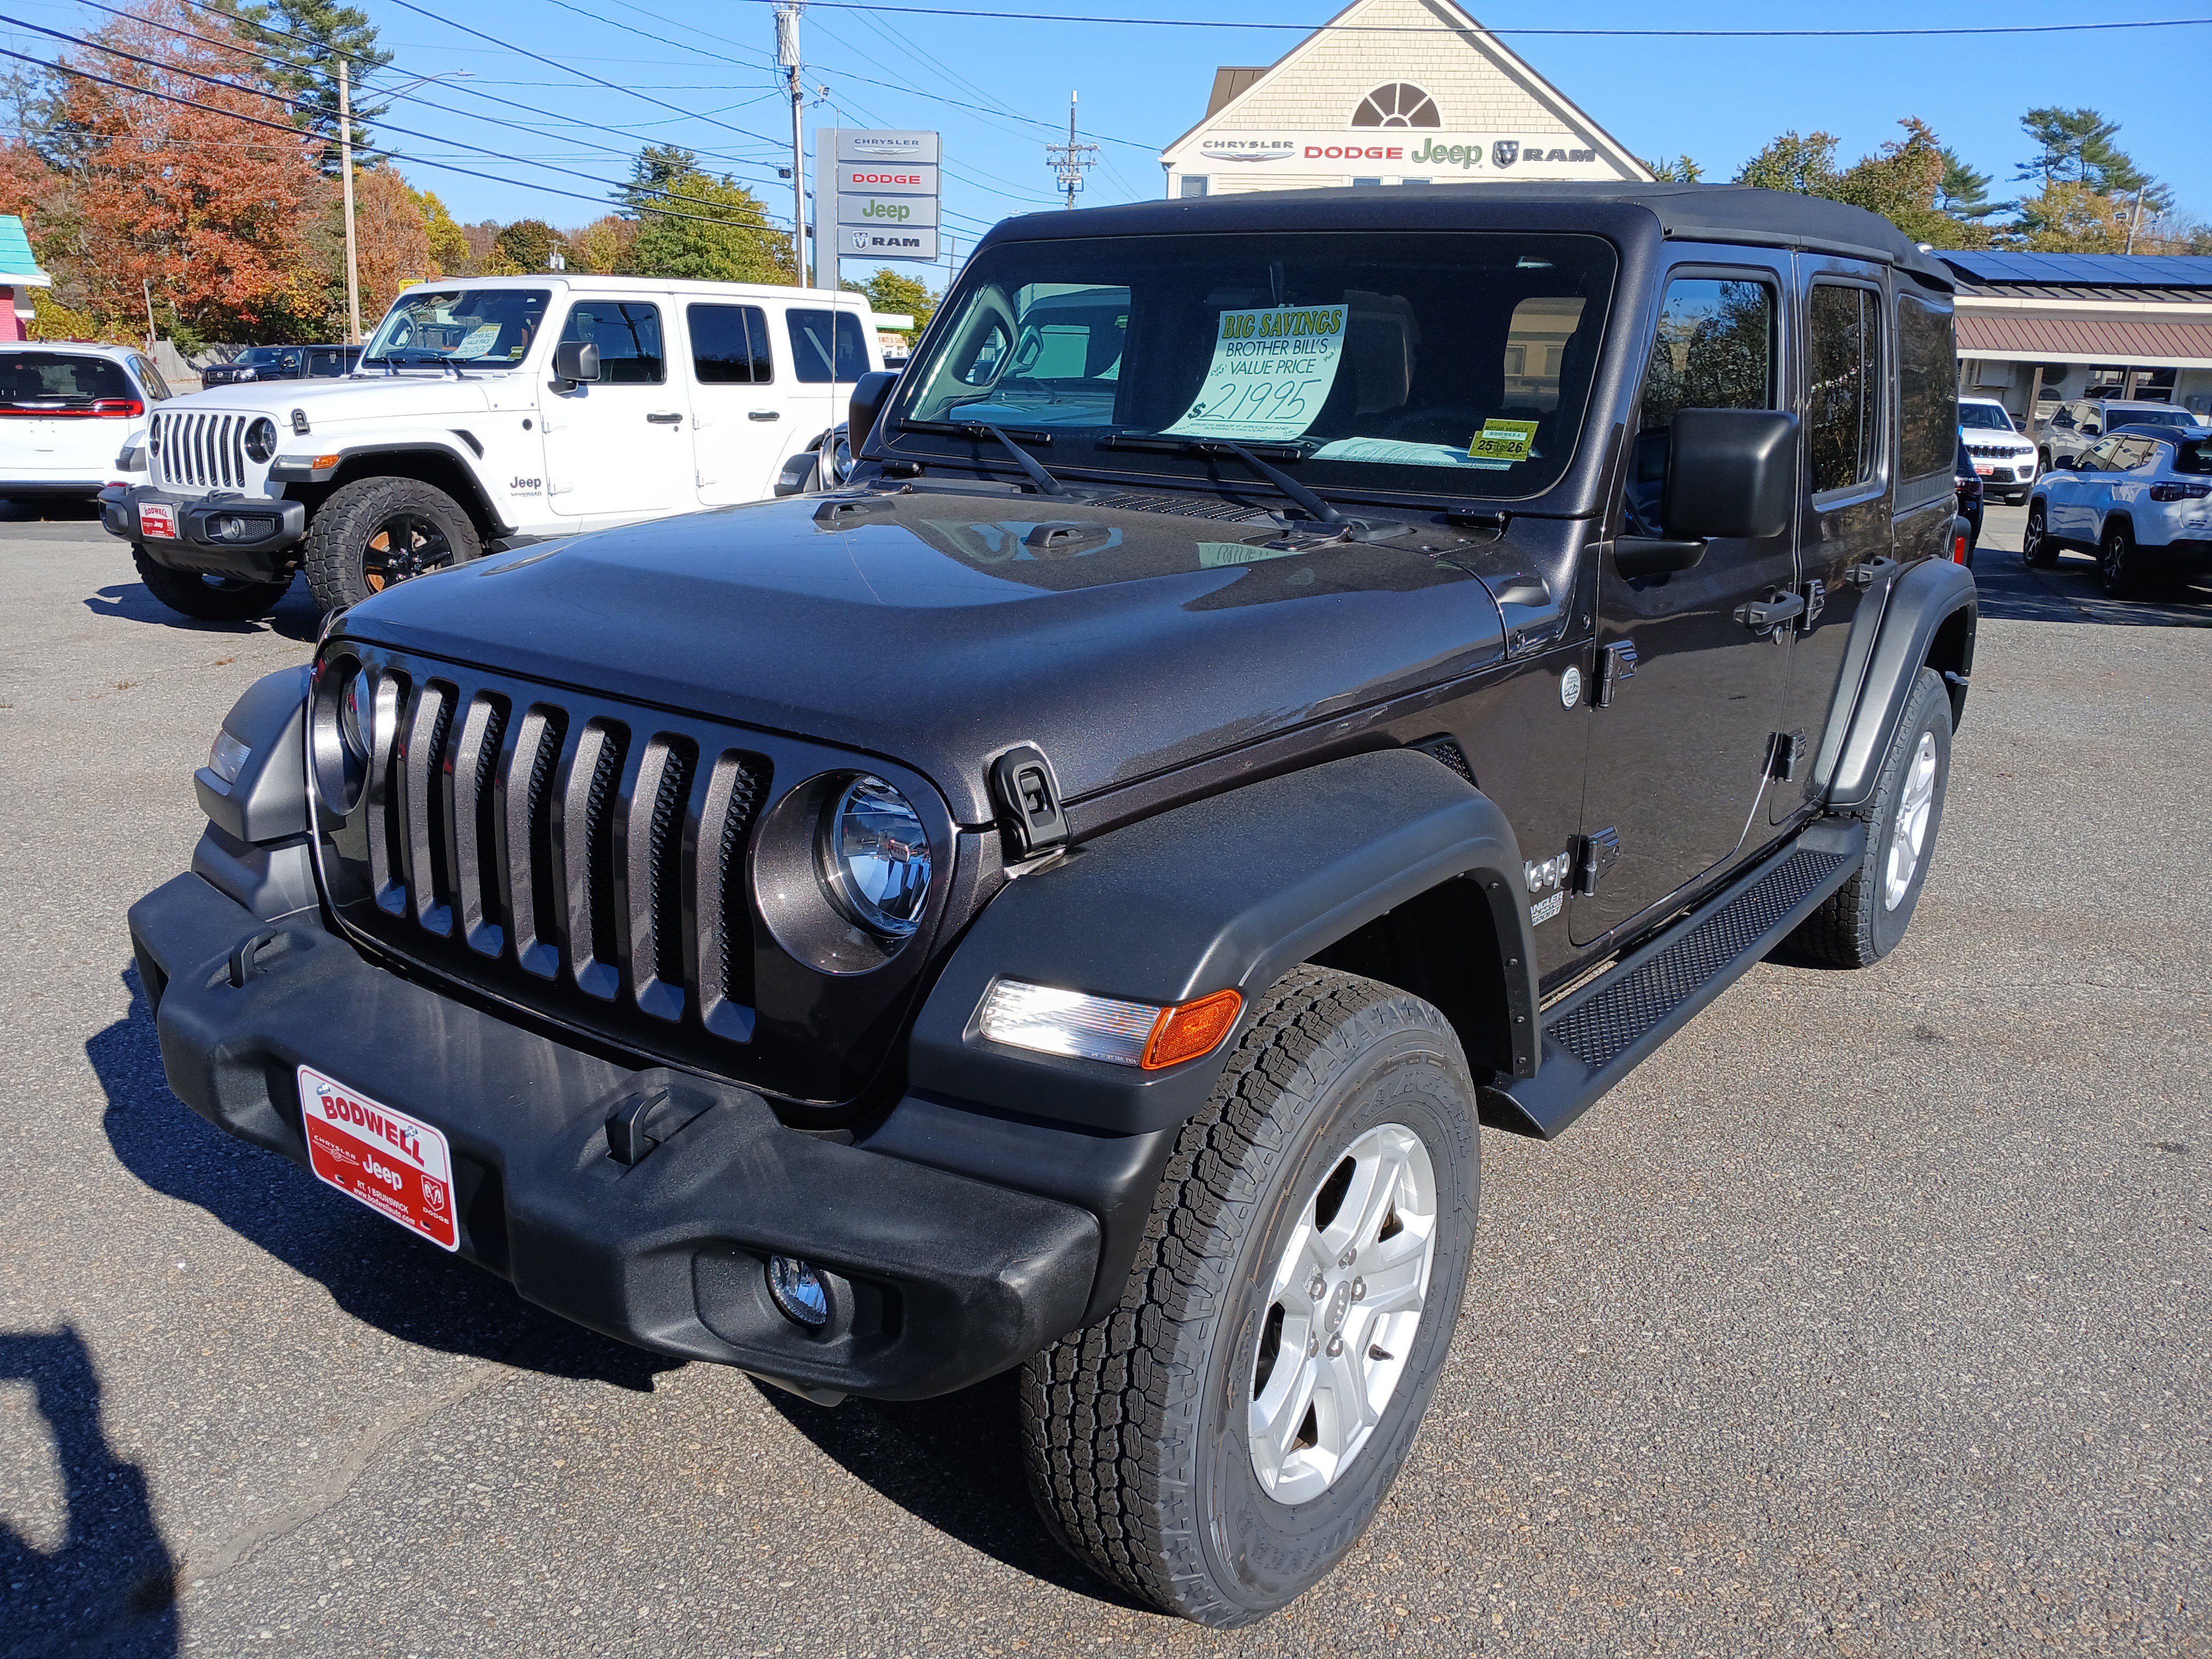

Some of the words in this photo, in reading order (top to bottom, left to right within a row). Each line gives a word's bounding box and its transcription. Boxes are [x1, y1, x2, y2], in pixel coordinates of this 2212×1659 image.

[1202, 140, 1294, 149] CHRYSLER
[1304, 145, 1403, 159] DODGE
[1412, 138, 1483, 169] Jeep
[1523, 149, 1597, 162] RAM
[852, 173, 921, 185] DODGE
[862, 199, 910, 222] Jeep
[872, 236, 920, 247] RAM
[1222, 314, 1256, 339] BIG
[1258, 309, 1342, 338] SAVINGS
[1225, 339, 1289, 357] BROTHER
[1293, 338, 1329, 355] BILL'S
[1230, 360, 1274, 375] VALUE
[1276, 358, 1316, 374] PRICE
[1477, 440, 1493, 451] 25
[1507, 441, 1524, 453] 26
[510, 476, 542, 490] Jeep
[320, 1095, 425, 1168] BODWELL
[313, 1135, 357, 1160] CHRYSLER
[362, 1153, 403, 1191] Jeep
[353, 1187, 416, 1225] www.bodwellauto.com
[357, 1179, 367, 1191] RT.
[372, 1186, 409, 1215] BRUNSWICK
[422, 1206, 450, 1225] DODGE
